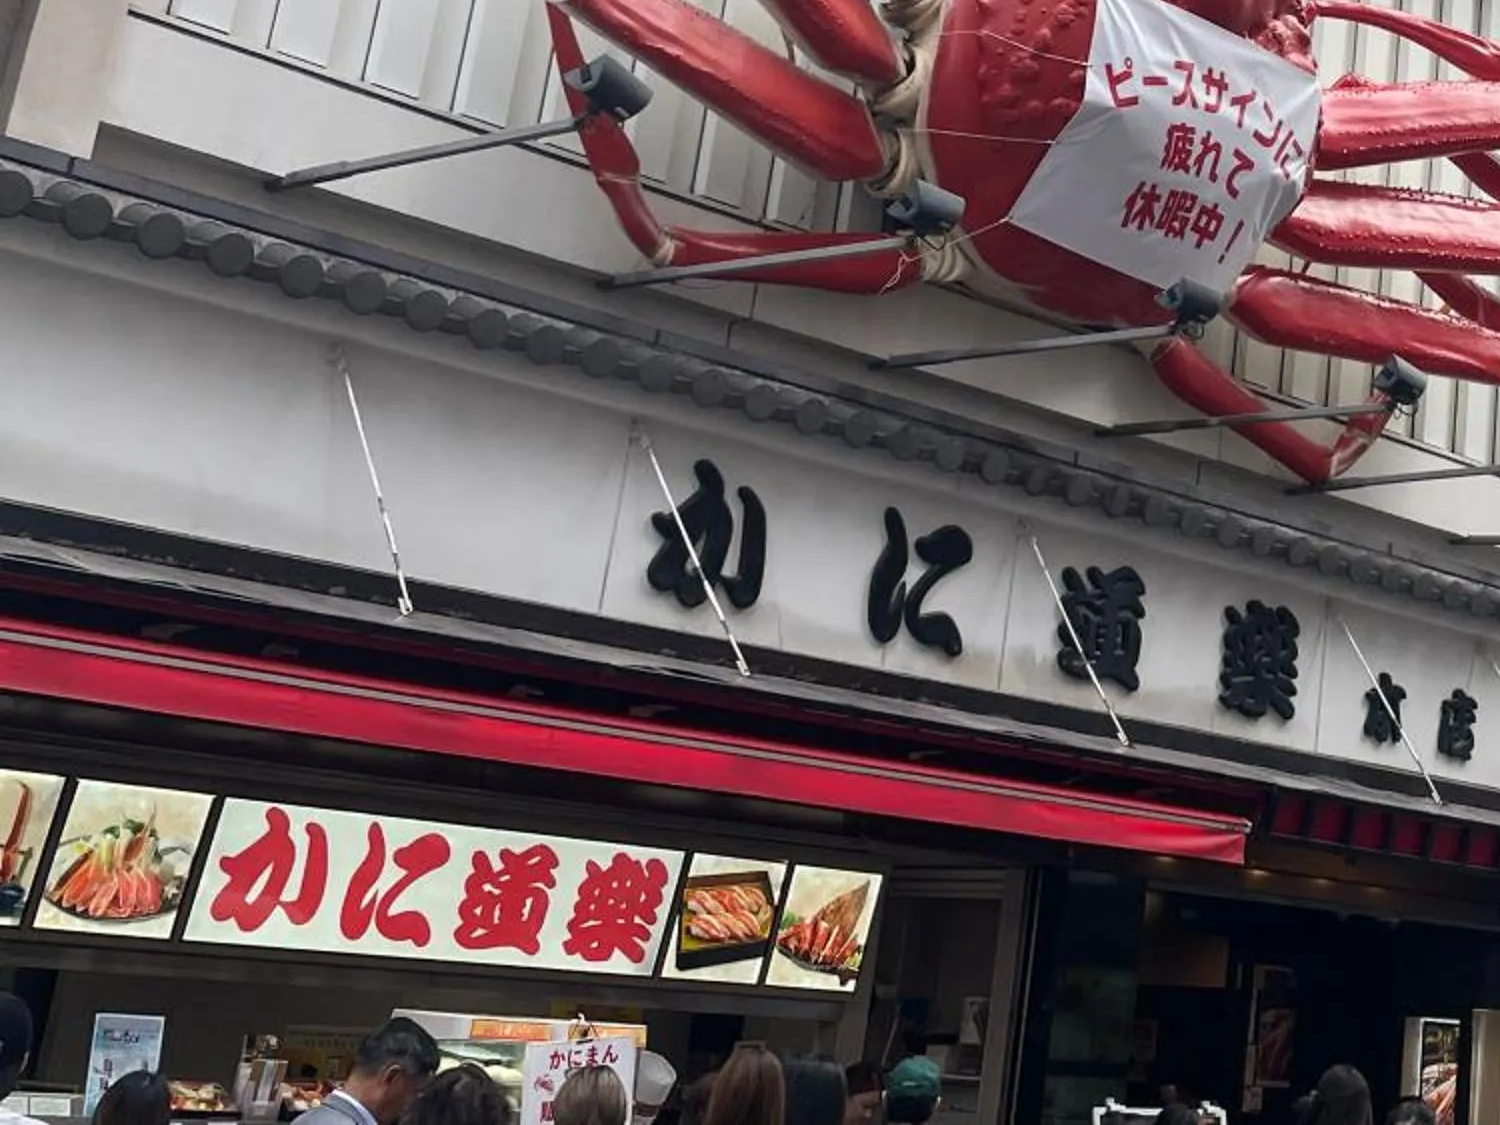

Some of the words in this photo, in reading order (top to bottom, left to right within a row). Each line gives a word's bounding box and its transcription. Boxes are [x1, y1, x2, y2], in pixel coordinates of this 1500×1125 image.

[1104, 56, 1304, 179] ピースサインに
[1160, 122, 1254, 199] 疲れて
[1120, 181, 1245, 264] 休暇中！
[549, 1044, 620, 1071] かにまん
